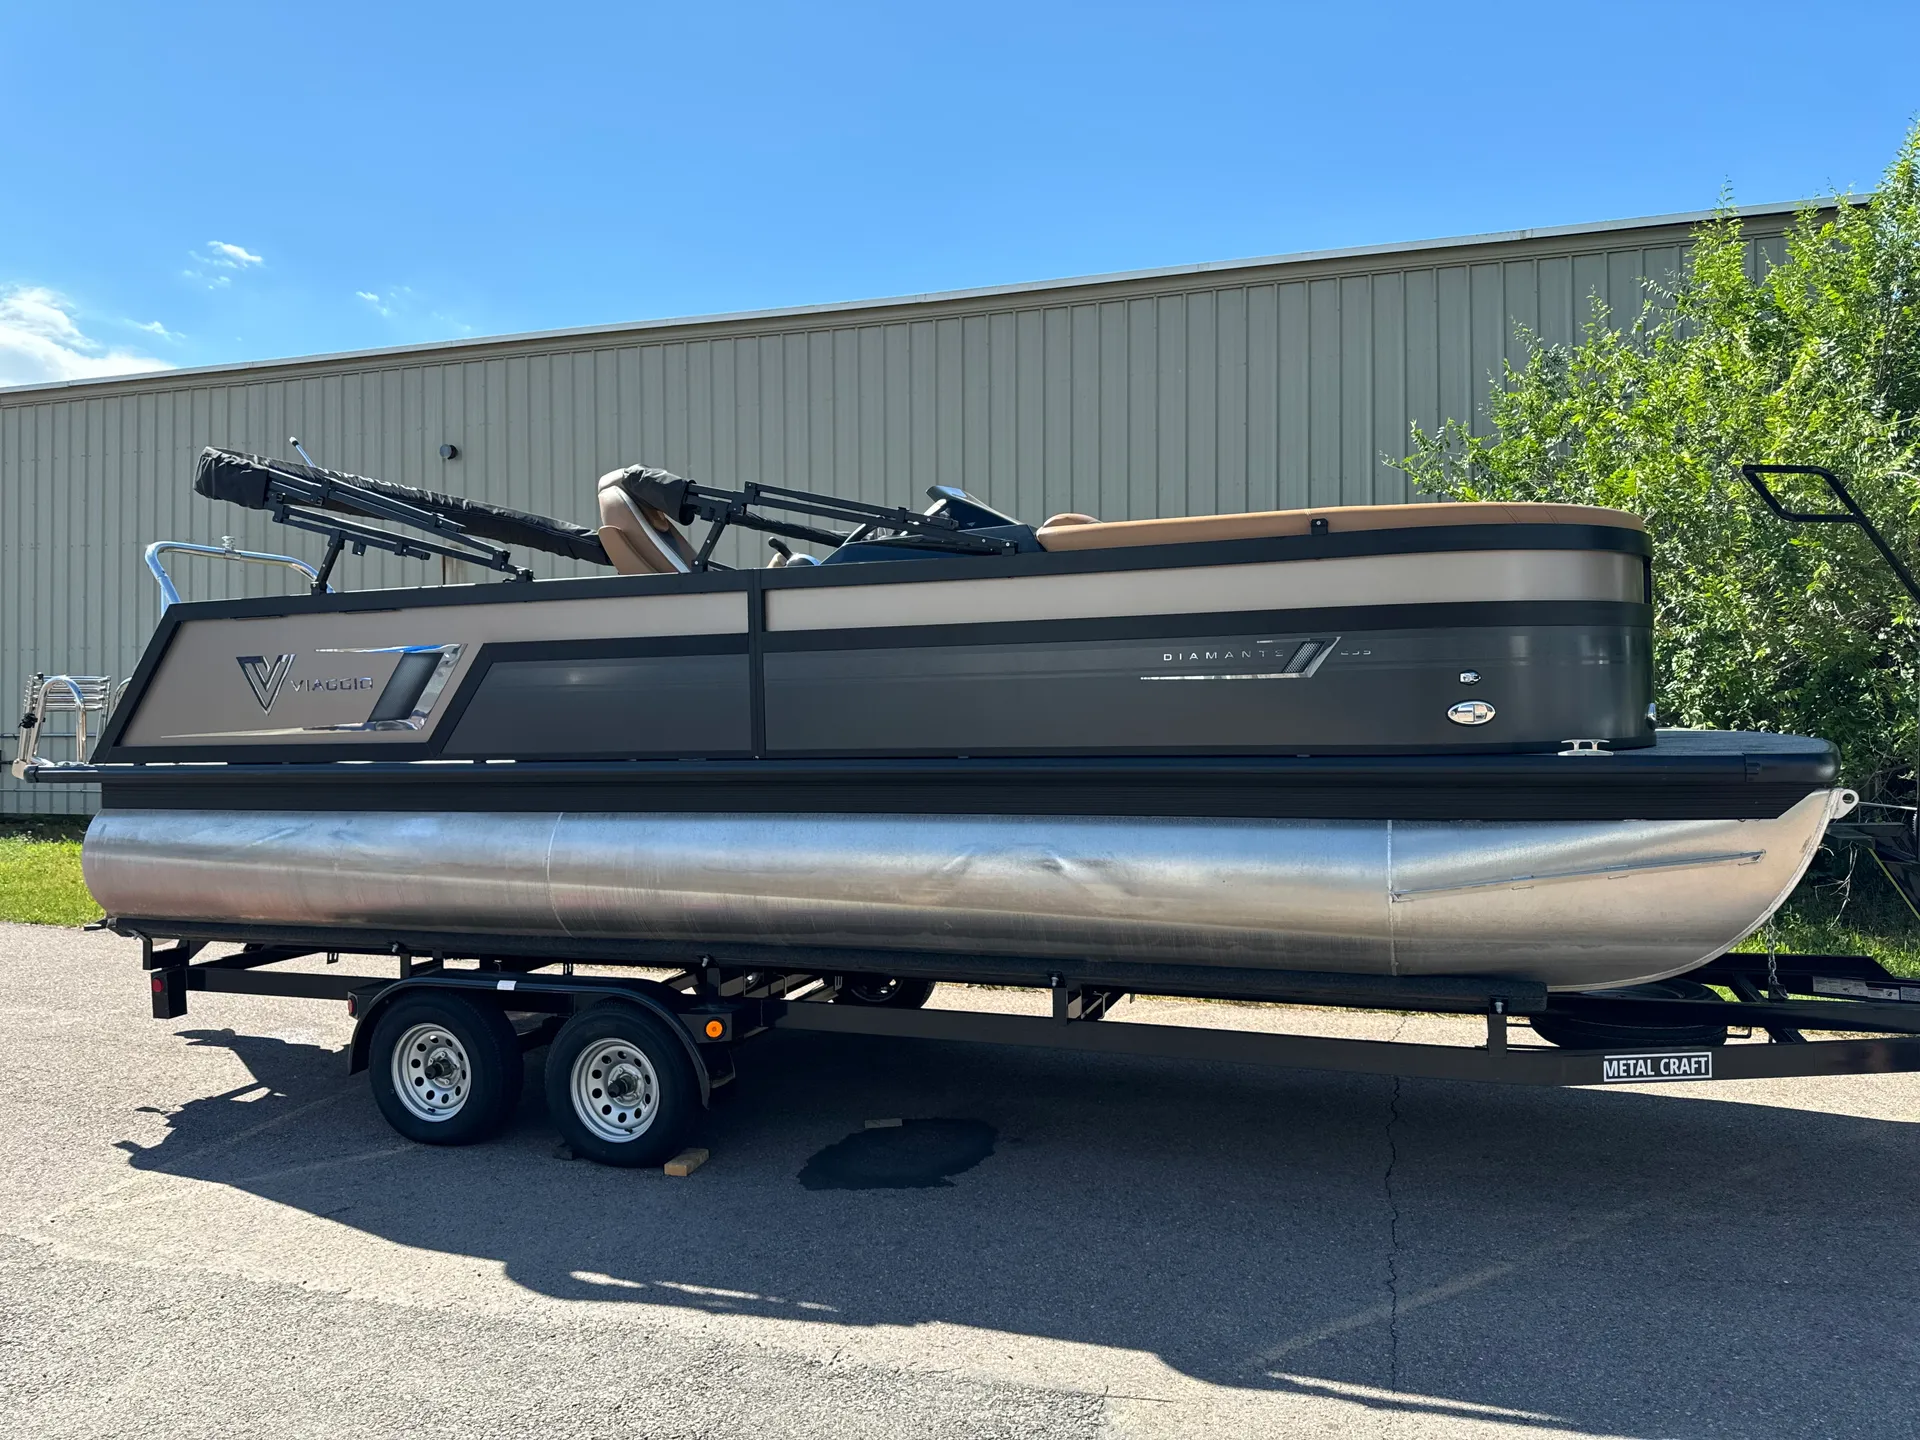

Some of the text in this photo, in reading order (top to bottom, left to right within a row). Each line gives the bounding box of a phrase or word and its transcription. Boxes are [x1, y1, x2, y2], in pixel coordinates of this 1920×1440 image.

[1163, 649, 1284, 661] DIAMANTE
[290, 677, 373, 693] VIAGGIO
[1604, 1057, 1708, 1077] METAL CRAFT
